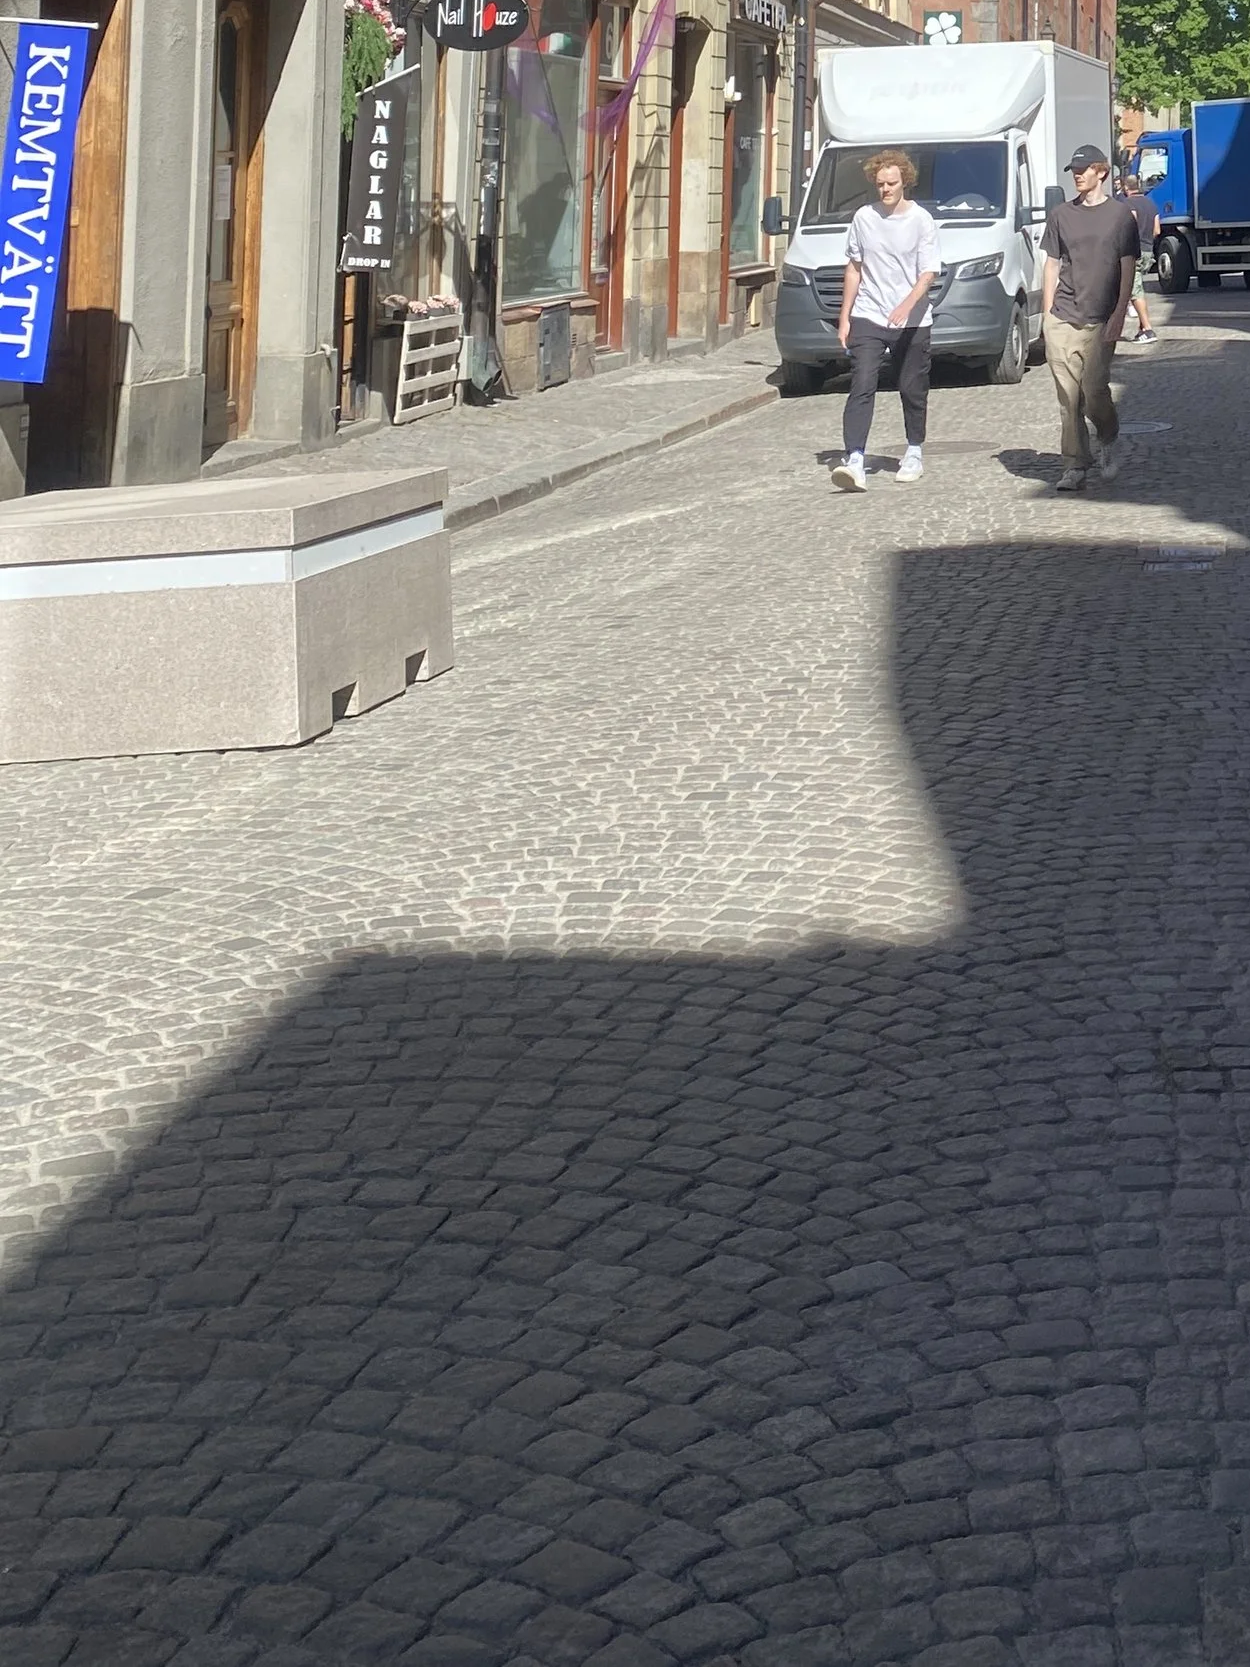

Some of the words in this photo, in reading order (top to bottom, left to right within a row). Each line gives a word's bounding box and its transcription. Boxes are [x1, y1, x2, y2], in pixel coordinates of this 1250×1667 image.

[0, 42, 71, 360] KEMTVÄTT
[362, 99, 392, 246] NAGLAR
[347, 256, 379, 267] DROP
[380, 258, 391, 269] IN
